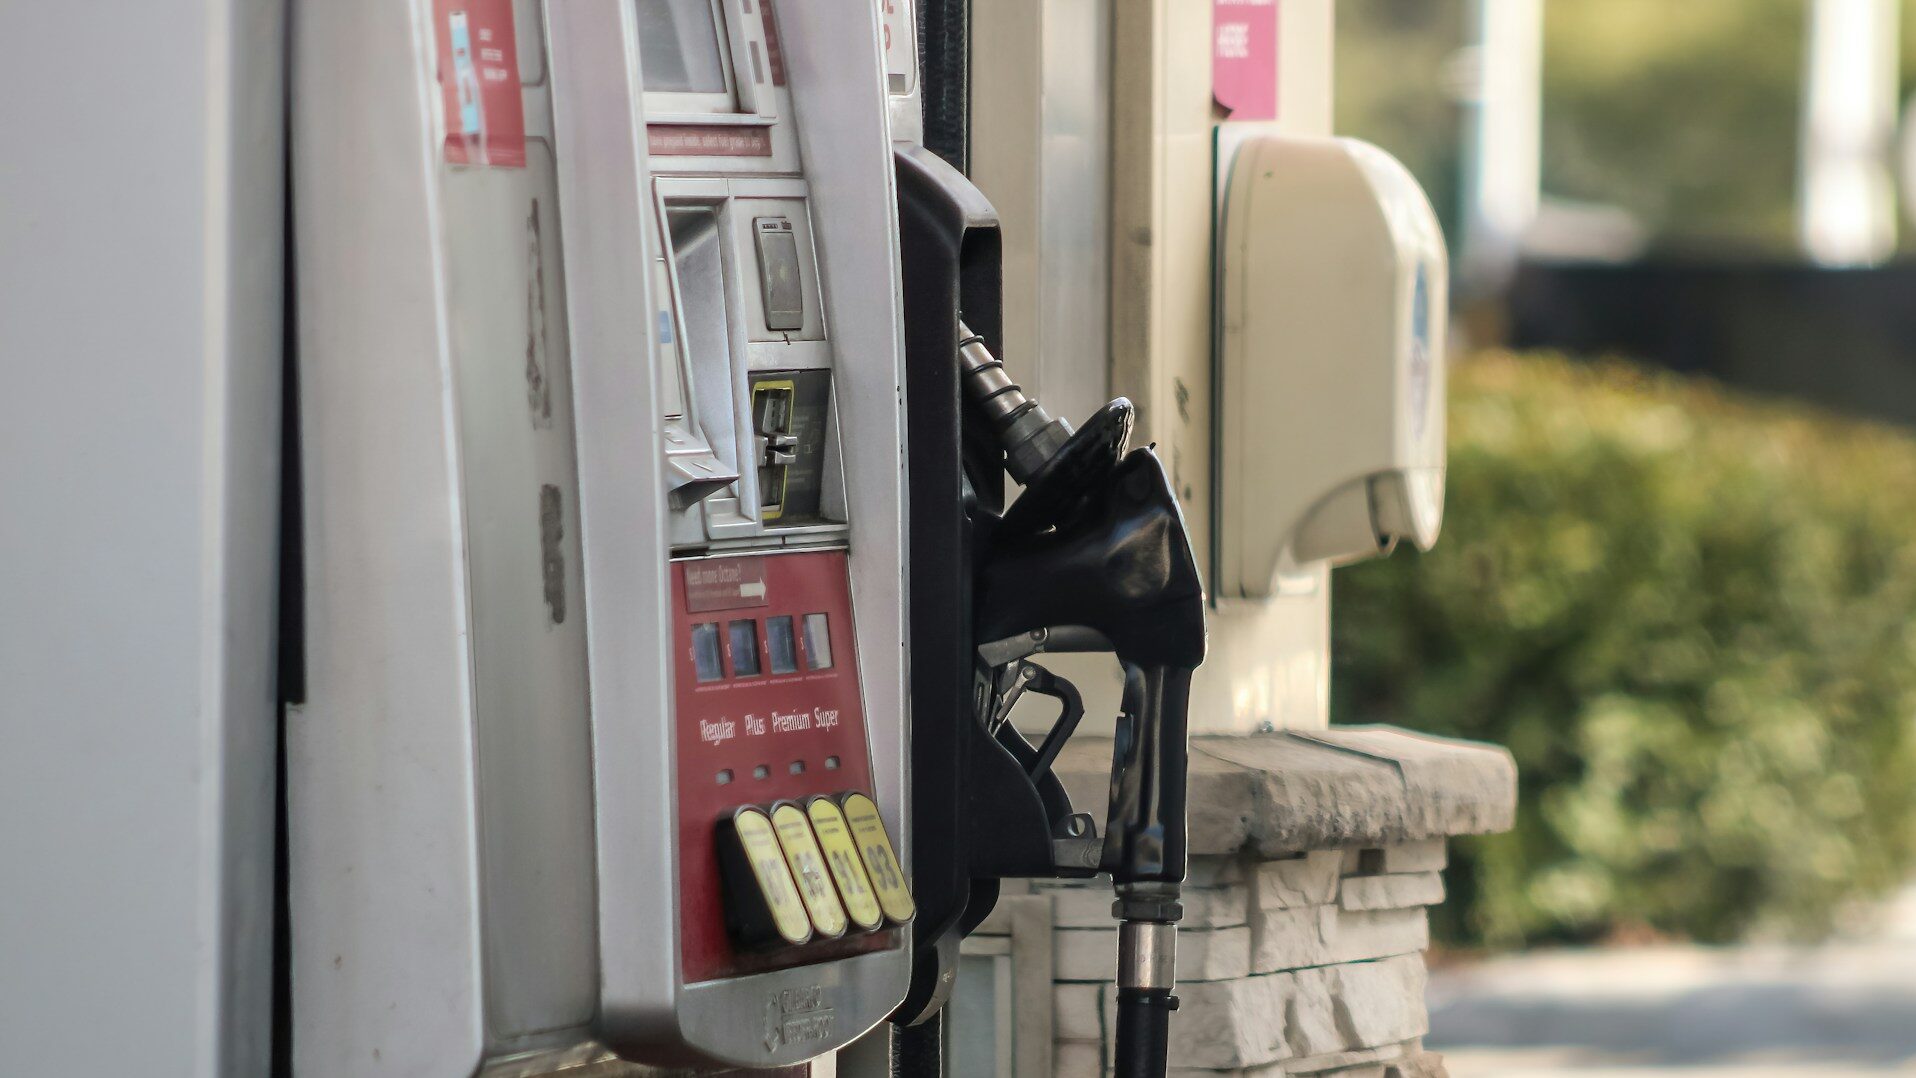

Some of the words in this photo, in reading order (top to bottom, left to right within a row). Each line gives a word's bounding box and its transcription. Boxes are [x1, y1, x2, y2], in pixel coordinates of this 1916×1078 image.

[700, 717, 735, 746] Regular
[745, 713, 766, 736] Plus
[771, 708, 810, 732] Premium
[814, 707, 839, 732] Super
[832, 850, 865, 894] 91
[866, 844, 899, 890] 93
